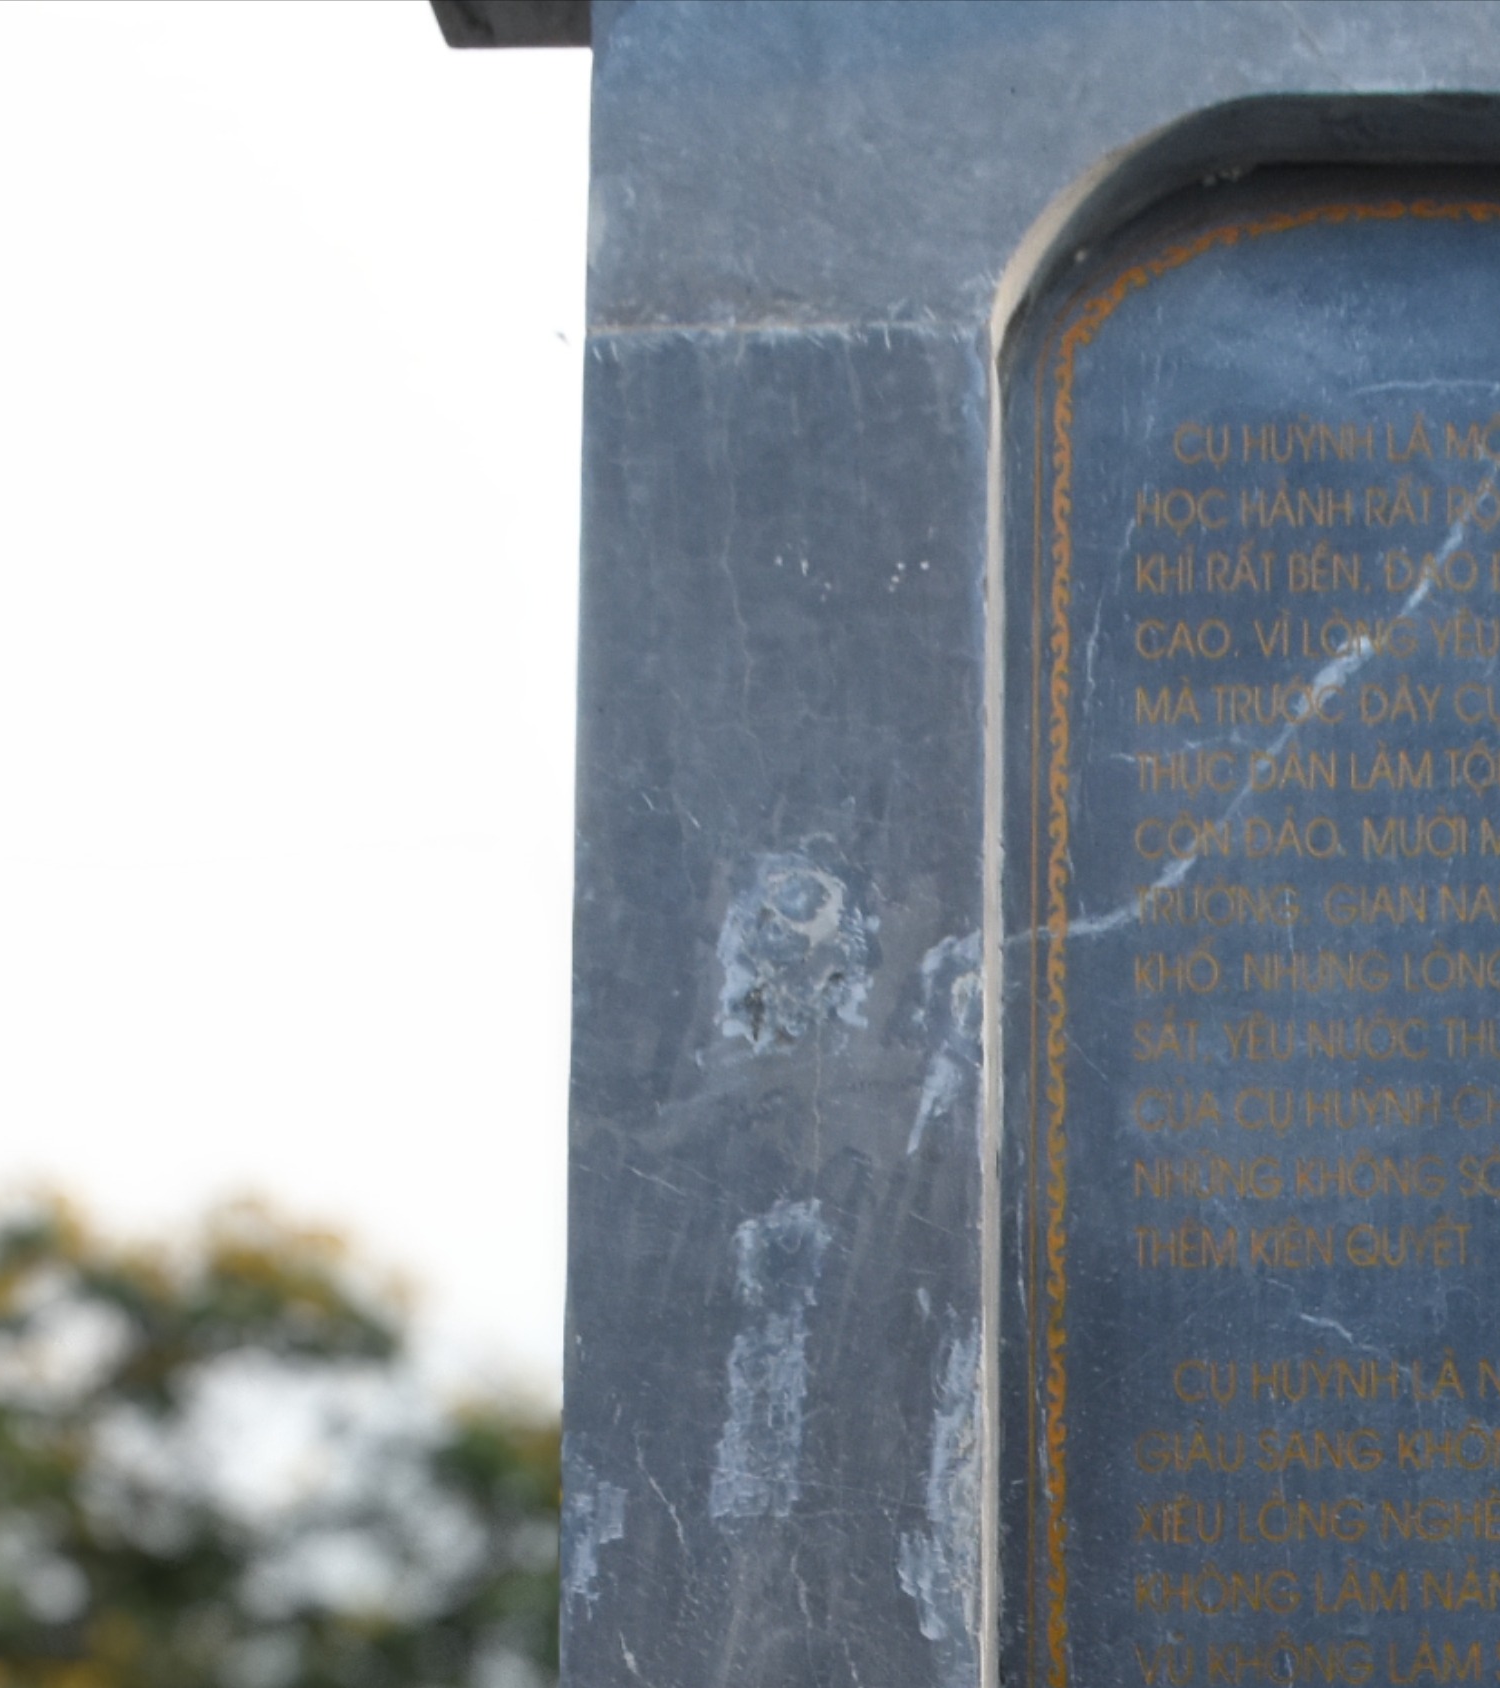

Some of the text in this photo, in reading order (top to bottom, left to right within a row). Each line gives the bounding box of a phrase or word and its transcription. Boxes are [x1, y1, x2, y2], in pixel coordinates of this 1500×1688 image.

[1172, 420, 1231, 470] CỤ
[1243, 413, 1374, 463] HUỲNH
[1386, 411, 1433, 463] LÀ
[1135, 487, 1227, 536] HỌC
[1240, 479, 1353, 527] HÀNH
[1365, 475, 1433, 527] RẤT
[1135, 546, 1194, 594] KHÍ
[1207, 540, 1275, 593] RẤT
[1252, 609, 1291, 658] VÌ
[1302, 609, 1418, 659] LÒNG
[1429, 608, 1500, 658] YÊU
[1135, 676, 1201, 725] MÀ
[1212, 676, 1345, 725] TRƯỚC
[1359, 674, 1443, 726] ĐÂY
[1135, 750, 1236, 798] THỰC
[1248, 743, 1338, 793] DÂN
[1349, 741, 1433, 793] LÀM
[1134, 811, 1231, 859] CÔN
[1361, 806, 1468, 859] MƯỜI
[1323, 882, 1428, 926] GIAN
[1223, 1010, 1294, 1061] YÊU
[1307, 1009, 1429, 1061] NƯỚC
[1131, 1077, 1223, 1131] CỦA
[1234, 1086, 1293, 1137] CỤ
[1305, 1078, 1441, 1129] HUỲNH
[1296, 1148, 1447, 1198] KHÔNG
[1133, 1218, 1238, 1269] THÊM
[1250, 1217, 1334, 1269] KIÊN
[1173, 1359, 1237, 1409] CỤ
[1251, 1348, 1399, 1403] HUỲNH
[1412, 1346, 1467, 1402] LÀ
[1135, 1422, 1245, 1473] GIÀU
[1257, 1428, 1385, 1472] SANG
[1134, 1493, 1224, 1544] XIÊU
[1238, 1488, 1368, 1544] LÒNG
[1135, 1562, 1302, 1614] KHÔNG
[1315, 1559, 1409, 1614] LÀM
[1208, 1632, 1375, 1685] KHÔNG
[1388, 1629, 1483, 1685] LÀM
